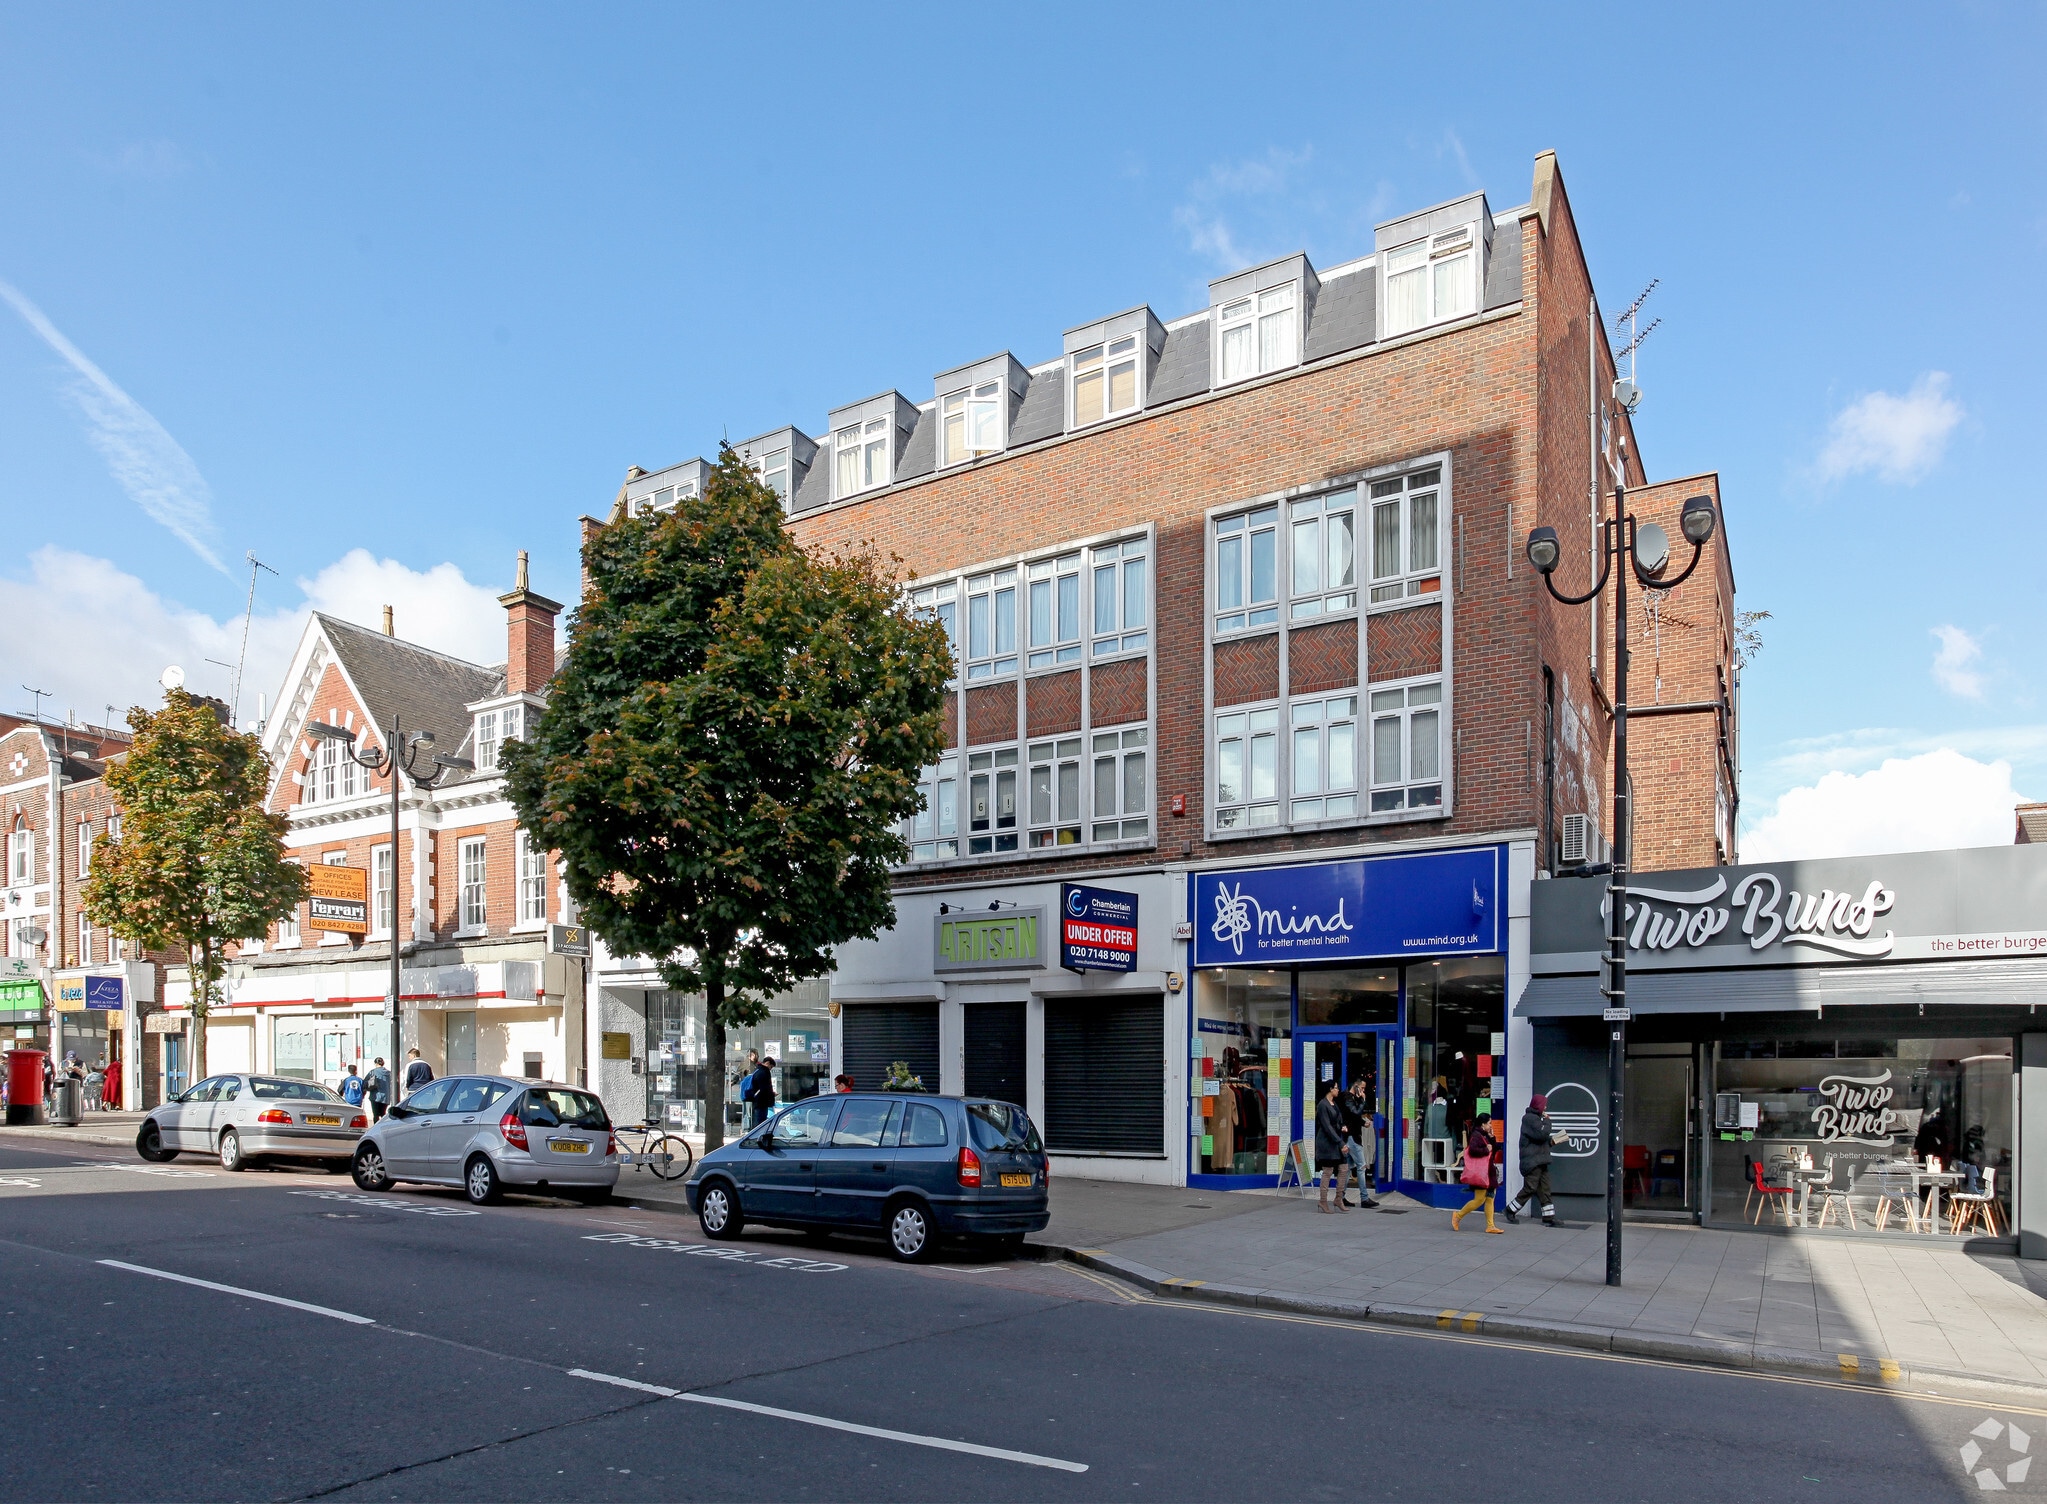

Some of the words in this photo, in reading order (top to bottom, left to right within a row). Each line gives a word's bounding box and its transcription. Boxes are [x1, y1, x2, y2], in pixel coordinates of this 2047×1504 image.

[323, 872, 352, 881] OFFICES
[312, 888, 333, 896] NEW
[335, 890, 363, 899] LEASE
[311, 899, 365, 917] Ferrari
[1091, 898, 1131, 912] Chamberlain
[1093, 911, 1129, 920] COMMERCIAL
[1257, 897, 1354, 936] mind
[1600, 873, 1729, 950] Two
[1731, 872, 1897, 958] Buns
[327, 921, 345, 929] 8427
[346, 923, 365, 931] 4288
[1176, 926, 1191, 935] Abel
[1067, 924, 1102, 943] UNDER
[1103, 928, 1133, 946] OFFER
[1258, 938, 1268, 948] for
[1271, 937, 1294, 947] better
[1296, 936, 1323, 946] mental
[1324, 935, 1350, 944] health
[1402, 933, 1478, 947] www.mind.org.uk
[1931, 938, 1954, 951] the
[1957, 938, 2000, 951] better
[1070, 945, 1087, 957] 020
[1088, 948, 1109, 960] 7148
[1110, 951, 1130, 962] 9000
[1819, 1068, 1894, 1110] Two
[1811, 1104, 1897, 1148] Buns
[553, 1141, 571, 1151] KU08
[572, 1143, 586, 1153] ZHE
[1825, 1151, 1838, 1159] the
[1839, 1151, 1862, 1160] better
[1863, 1152, 1889, 1161] burger
[1002, 1174, 1018, 1184] Y575
[580, 1232, 850, 1272] DISABLED
